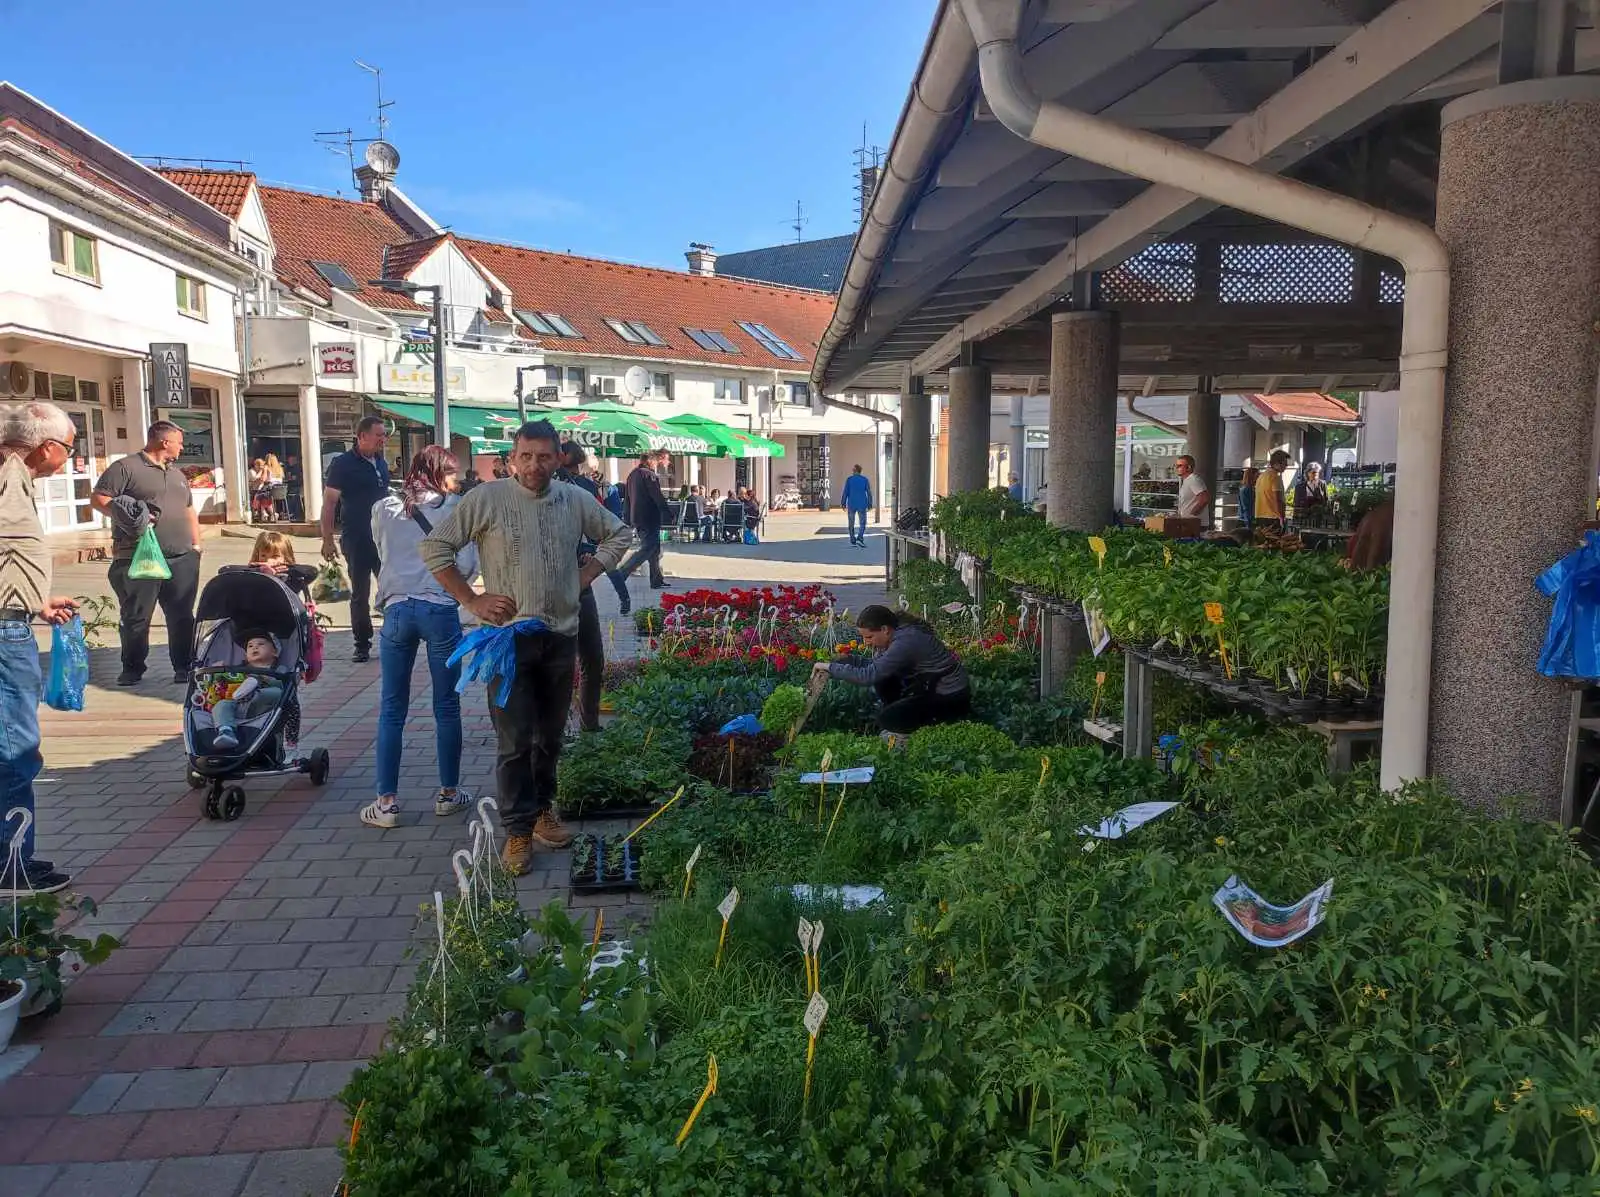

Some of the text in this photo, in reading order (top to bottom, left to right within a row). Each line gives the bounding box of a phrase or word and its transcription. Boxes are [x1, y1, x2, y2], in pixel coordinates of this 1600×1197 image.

[326, 361, 351, 372] RIS
[165, 351, 182, 404] ANNA
[649, 434, 709, 453] Heineken
